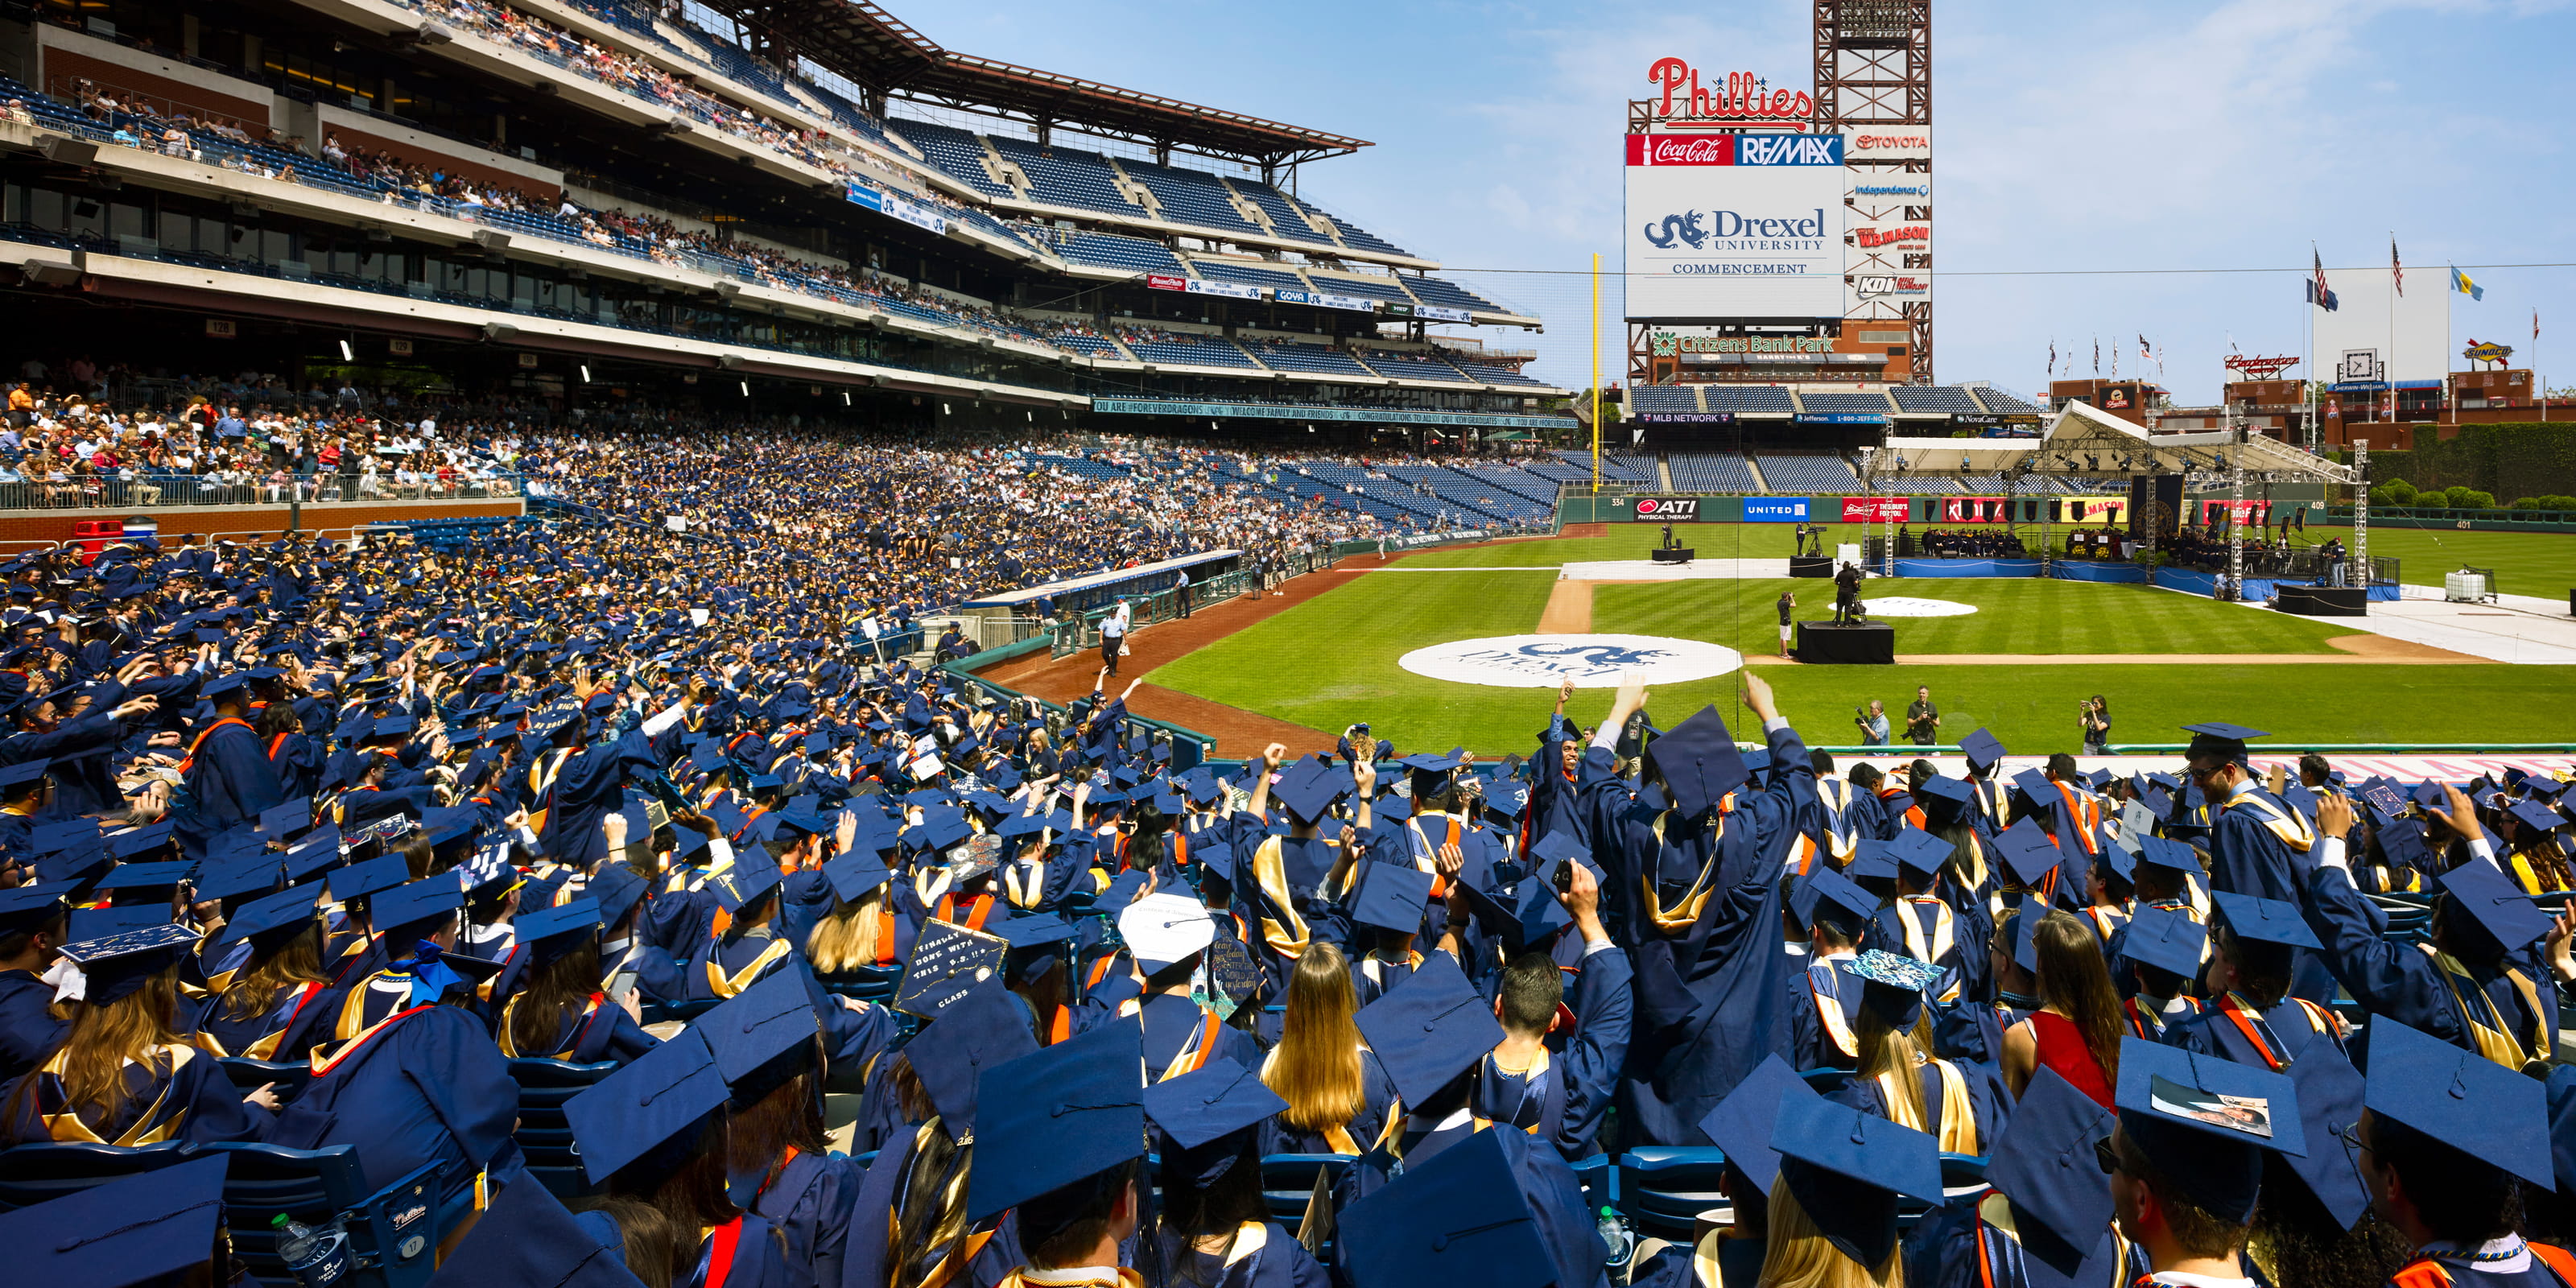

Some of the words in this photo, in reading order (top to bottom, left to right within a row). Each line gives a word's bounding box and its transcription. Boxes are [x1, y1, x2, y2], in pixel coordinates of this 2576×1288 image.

[1648, 57, 1813, 118] Phillies
[1874, 136, 1928, 147] TOYOTA
[1655, 138, 1722, 162] Coca-Cola
[1743, 136, 1835, 165] RE/MAX
[1856, 184, 1917, 196] Independence
[906, 204, 921, 215] WELCOME
[898, 211, 910, 220] FAMILY
[1712, 208, 1826, 237] Drexel
[1715, 240, 1823, 250] UNIVERSITY
[1673, 264, 1807, 274] COMMENCEMENT
[1280, 291, 1304, 301] GOYA
[213, 322, 229, 332] 128
[395, 341, 407, 351] 129
[1680, 336, 1748, 353] Citizens
[1751, 334, 1794, 353] Bank
[1796, 334, 1835, 353] Park
[2467, 348, 2509, 357] SUNOCO
[2224, 354, 2299, 369] Budweiser
[1111, 402, 1126, 412] ARE
[1231, 407, 1265, 416] WELCOME
[1267, 407, 1290, 418] FAMILY
[1291, 409, 1306, 418] AND
[1307, 409, 1334, 419] FRIENDS
[1358, 411, 1411, 422] CONGRATULATIONS
[1414, 413, 1422, 422] TO
[1517, 418, 1528, 426] YOU
[1529, 419, 1538, 427] ARE
[1653, 414, 1671, 422] MLB
[1674, 414, 1718, 422] NETWORK
[1964, 415, 1998, 423] NovaCare
[1612, 497, 1624, 506] 334
[1656, 500, 1696, 514] ATI
[2311, 501, 2324, 510] 409
[2457, 521, 2471, 529] 401
[1455, 649, 1621, 677] Drexel
[919, 931, 960, 952] FINALLY
[915, 951, 943, 966] DONE
[947, 939, 973, 953] WITH
[913, 964, 939, 980] THIS
[938, 989, 968, 1008] CLASS
[409, 1241, 416, 1253] 17
[324, 1271, 337, 1282] Park
